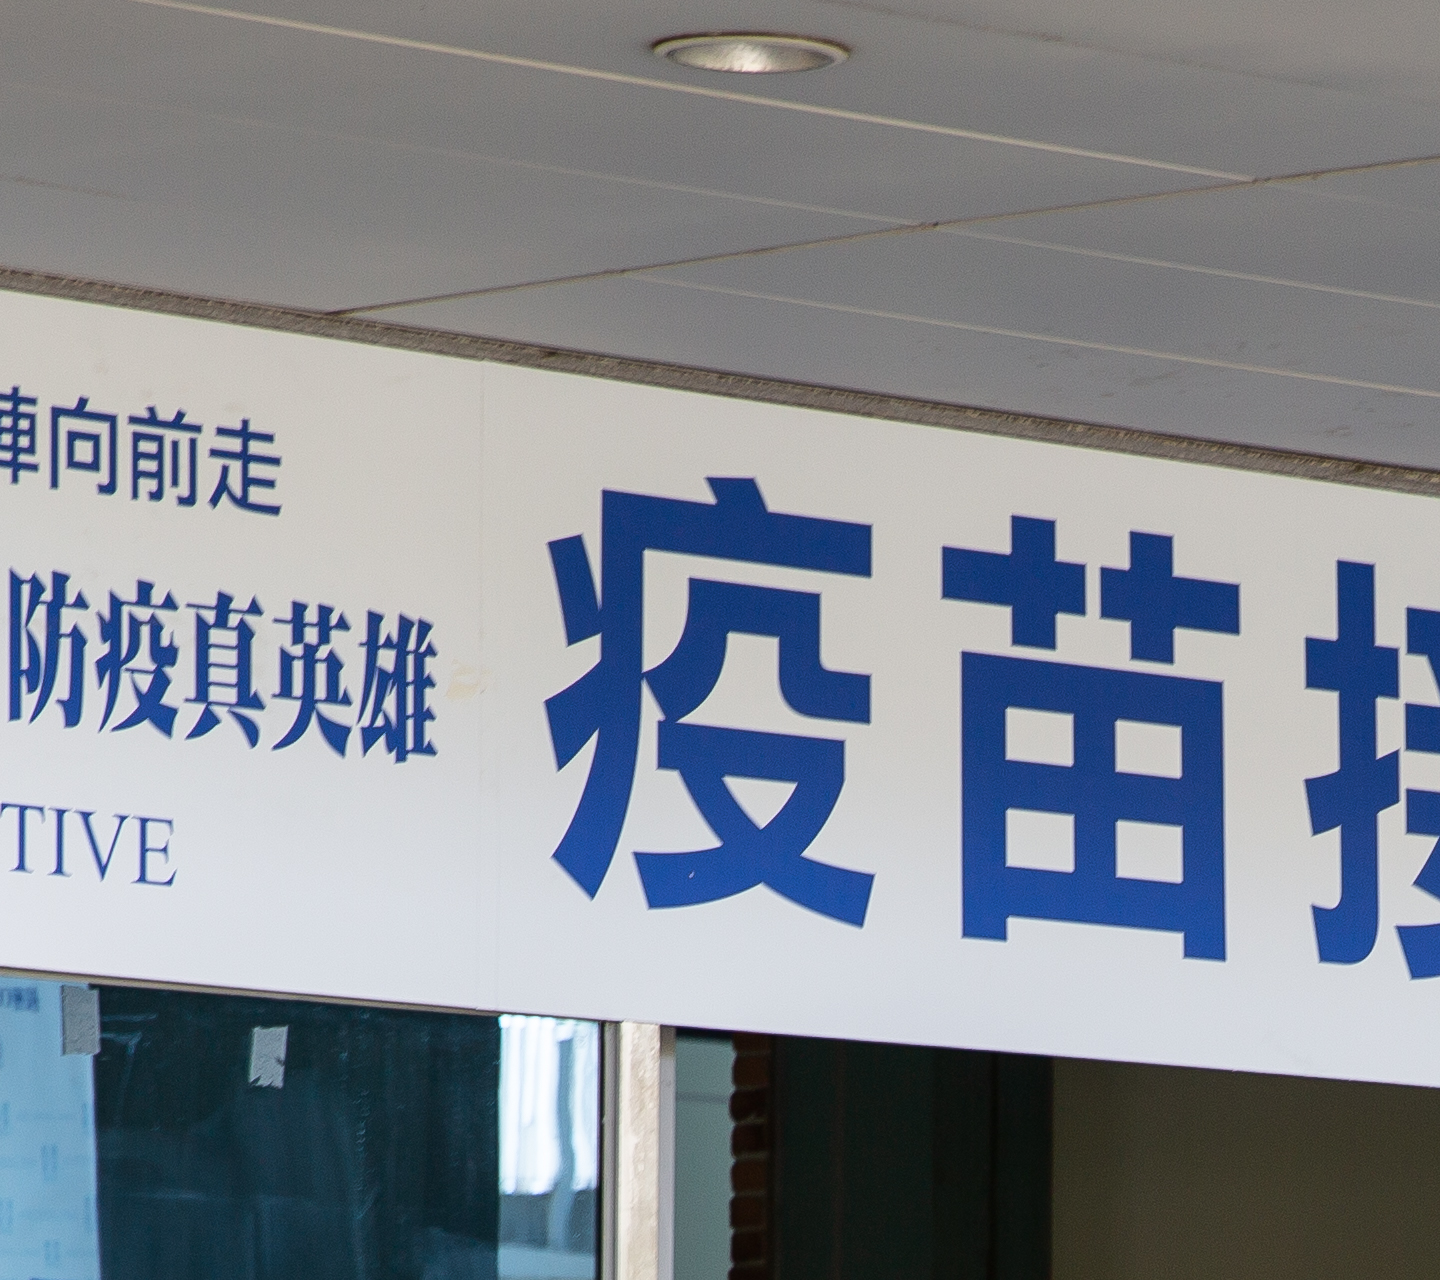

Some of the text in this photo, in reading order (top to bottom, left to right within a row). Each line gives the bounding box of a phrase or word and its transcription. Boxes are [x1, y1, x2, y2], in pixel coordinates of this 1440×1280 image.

[7, 566, 439, 764] 防疫真英雄
